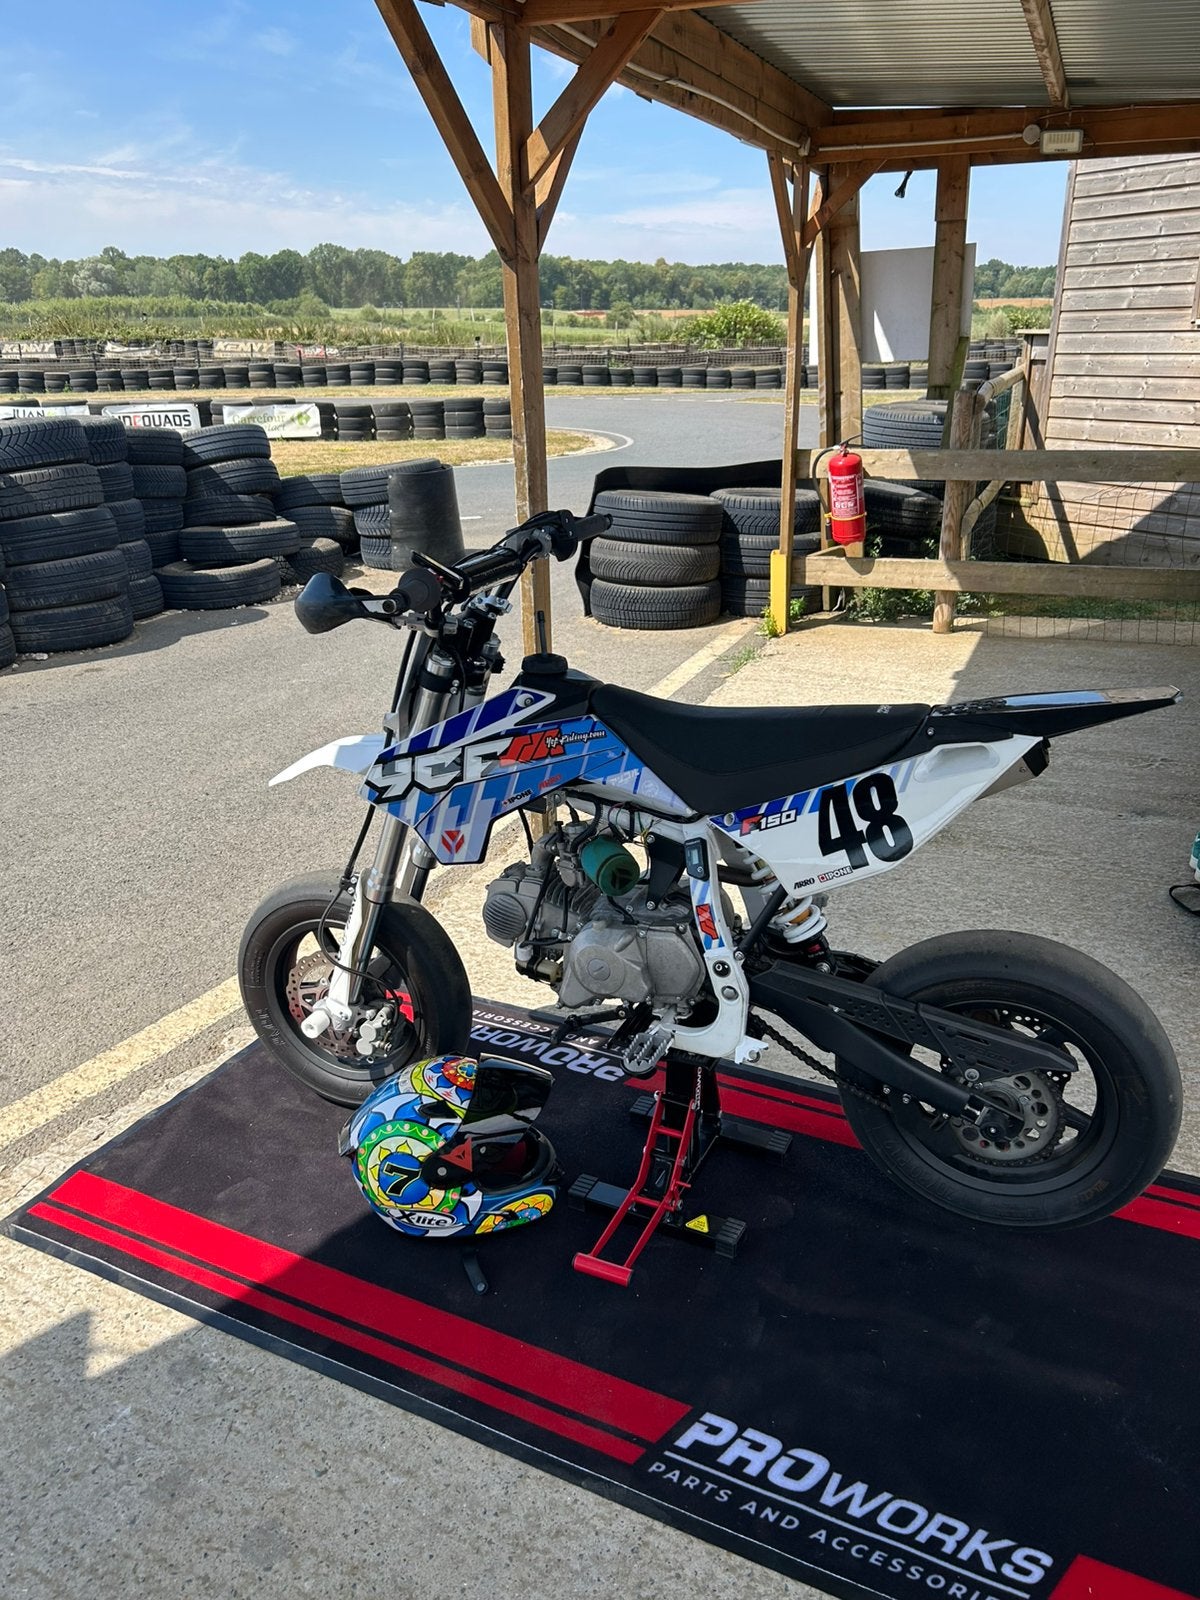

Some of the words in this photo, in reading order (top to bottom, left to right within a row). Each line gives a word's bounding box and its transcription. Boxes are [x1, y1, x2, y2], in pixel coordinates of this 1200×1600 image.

[214, 341, 274, 352] KENNY
[232, 412, 286, 424] Carrefour
[508, 788, 533, 803] IPONE
[818, 772, 914, 870] 48
[825, 866, 853, 882] IPONE
[383, 1161, 422, 1196] 7
[394, 1208, 448, 1227] X-lite
[648, 1461, 733, 1502] PARTS
[739, 1501, 800, 1530] AND
[673, 1411, 1054, 1585] PROWORKS
